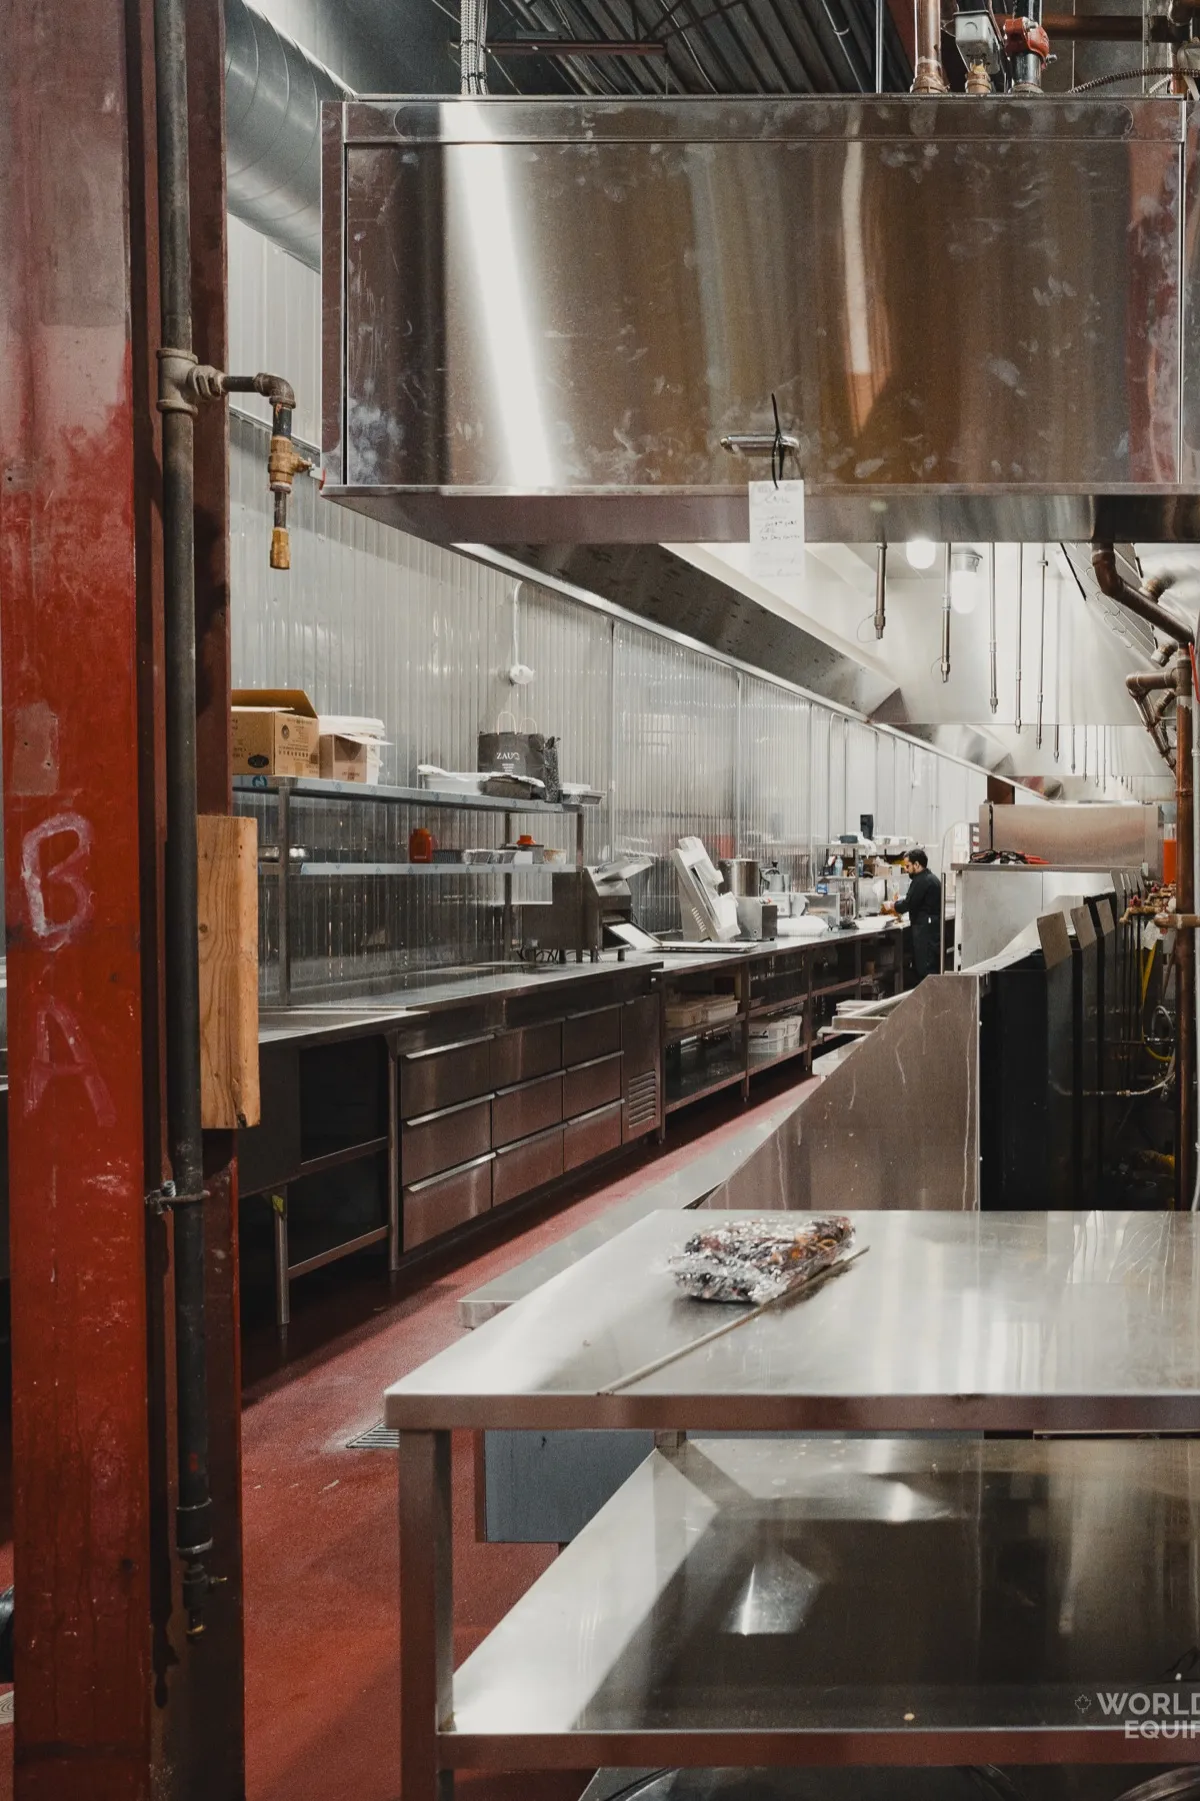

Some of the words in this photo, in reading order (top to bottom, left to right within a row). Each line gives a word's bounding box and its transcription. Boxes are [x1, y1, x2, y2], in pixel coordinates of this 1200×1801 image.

[496, 752, 521, 760] ZAUQ
[21, 810, 95, 952] B
[23, 995, 118, 1128] A
